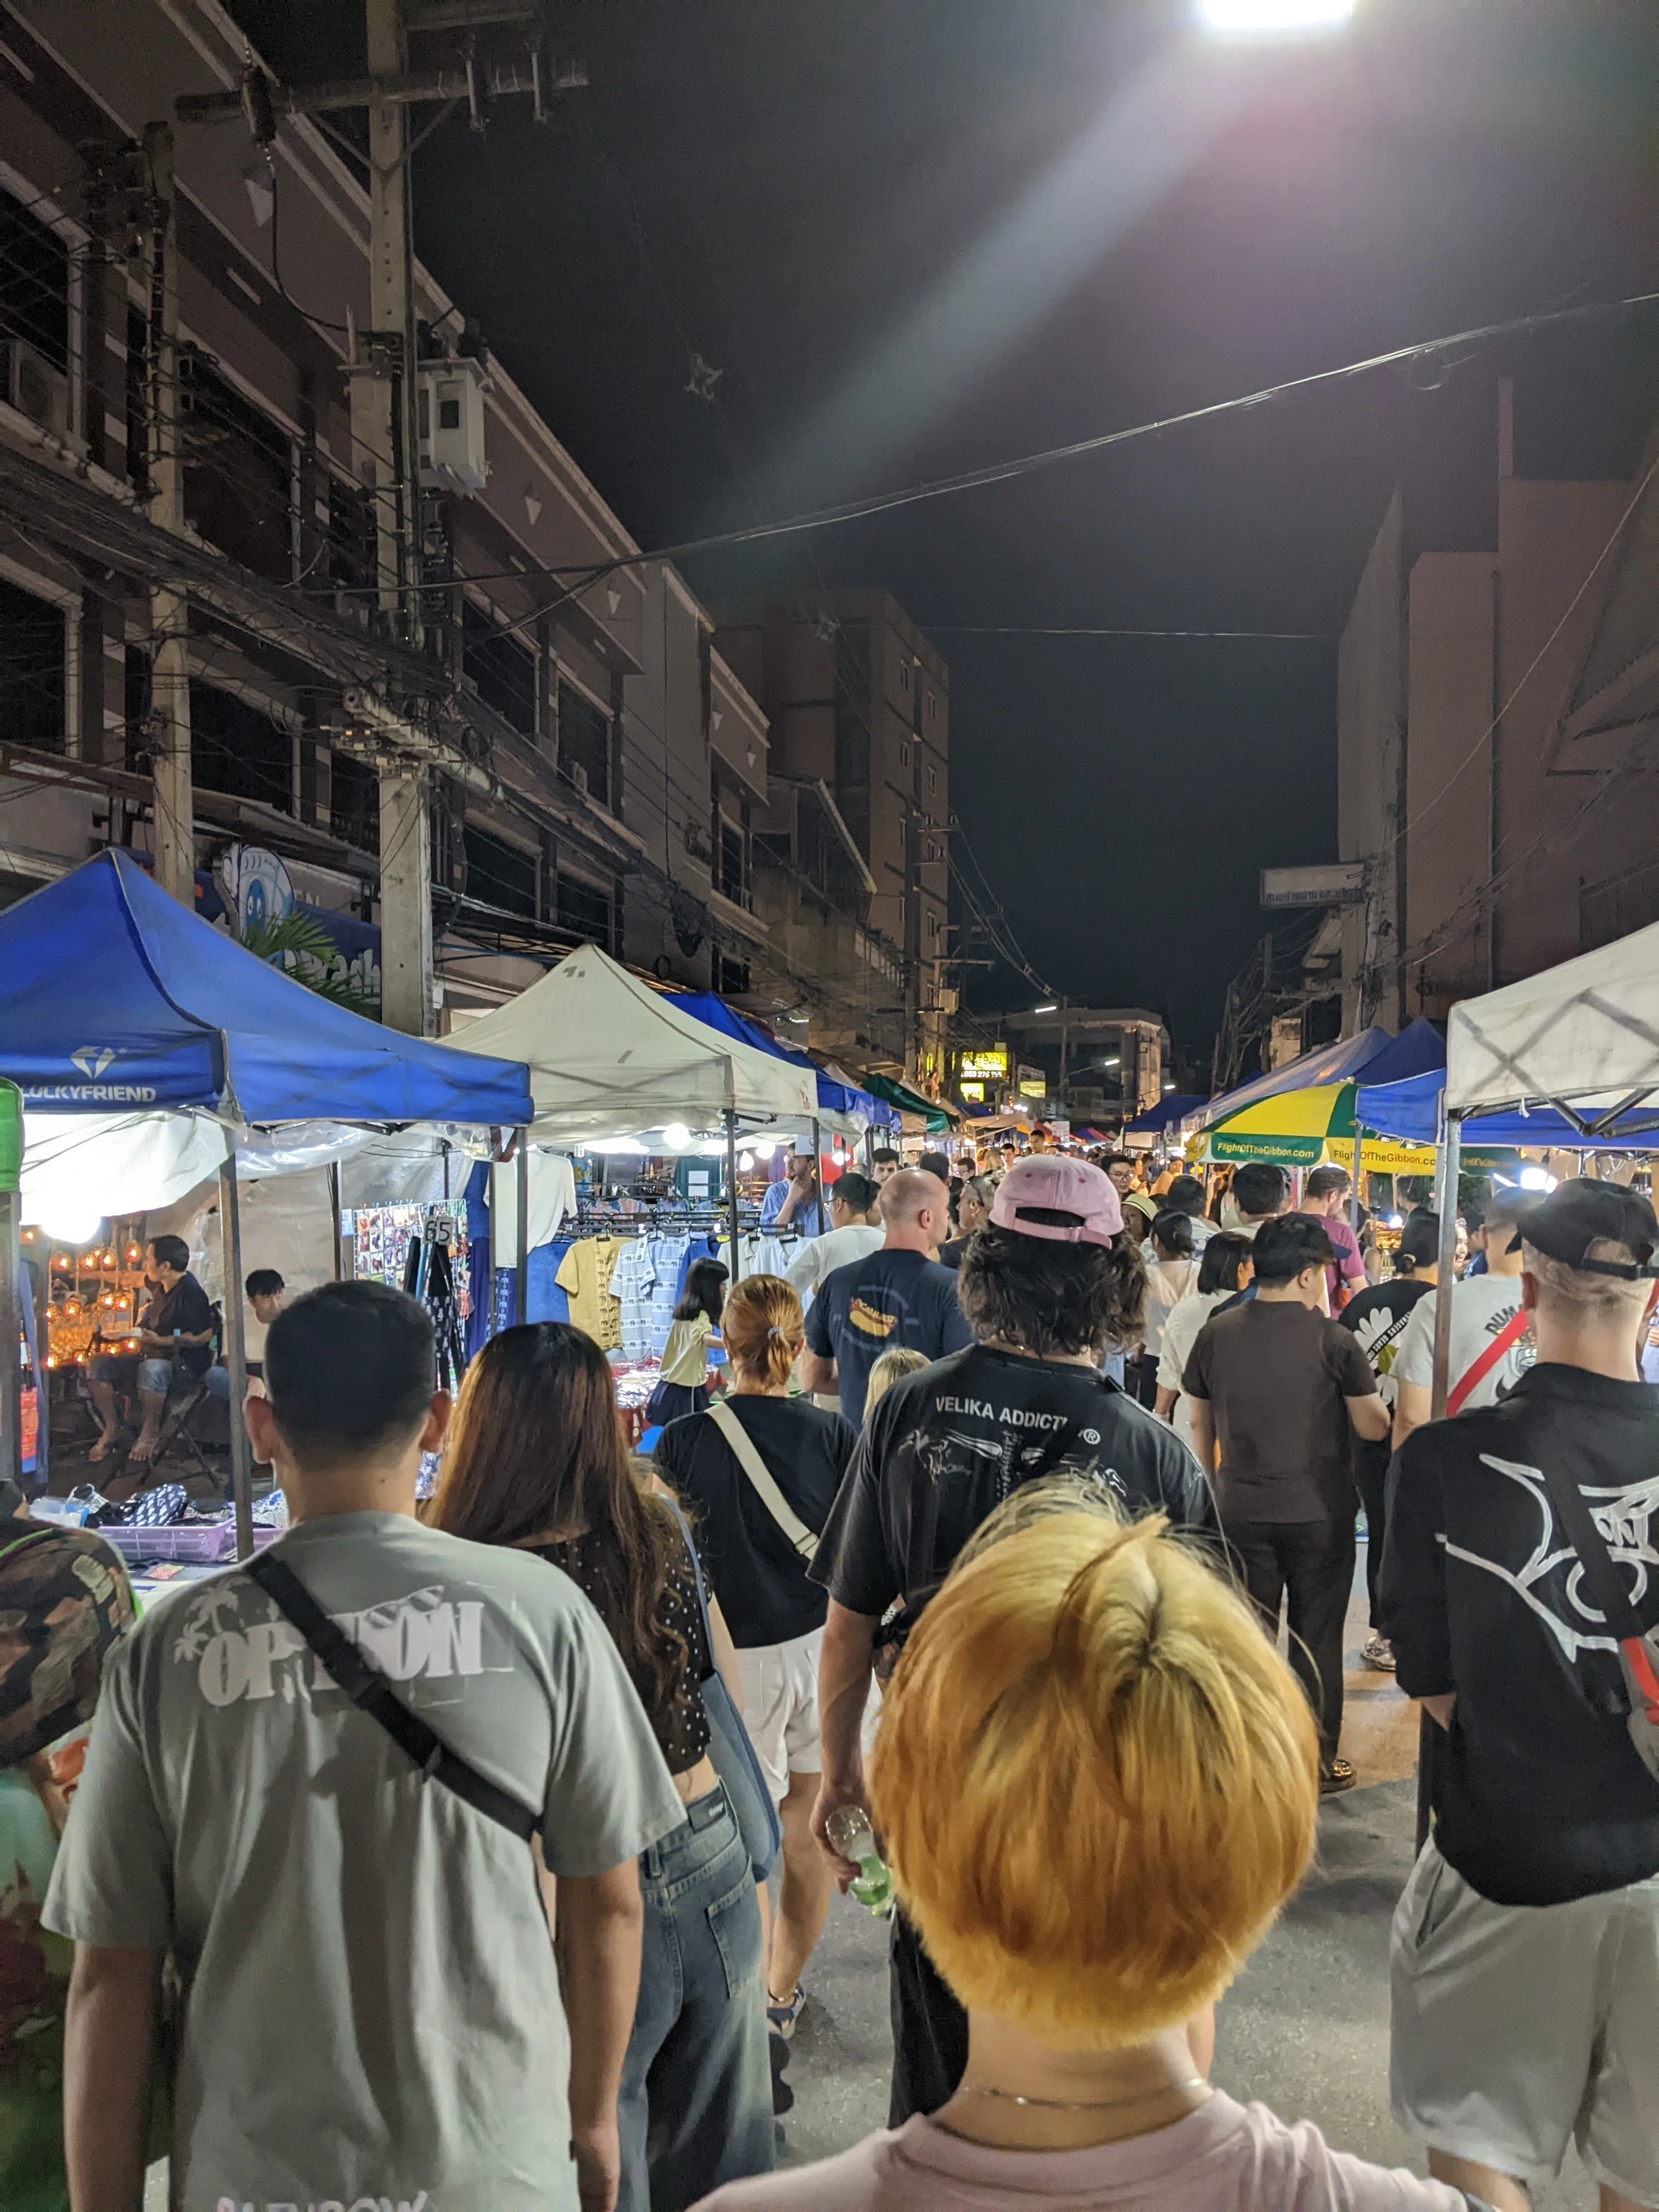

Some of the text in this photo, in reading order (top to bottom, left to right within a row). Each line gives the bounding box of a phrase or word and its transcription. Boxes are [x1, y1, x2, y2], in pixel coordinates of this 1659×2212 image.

[1217, 1142, 1314, 1158] FlightOfTheGibbon.com
[425, 1220, 450, 1242] 65
[935, 1396, 994, 1420] VELIKA
[998, 1406, 1068, 1431] ADDICT
